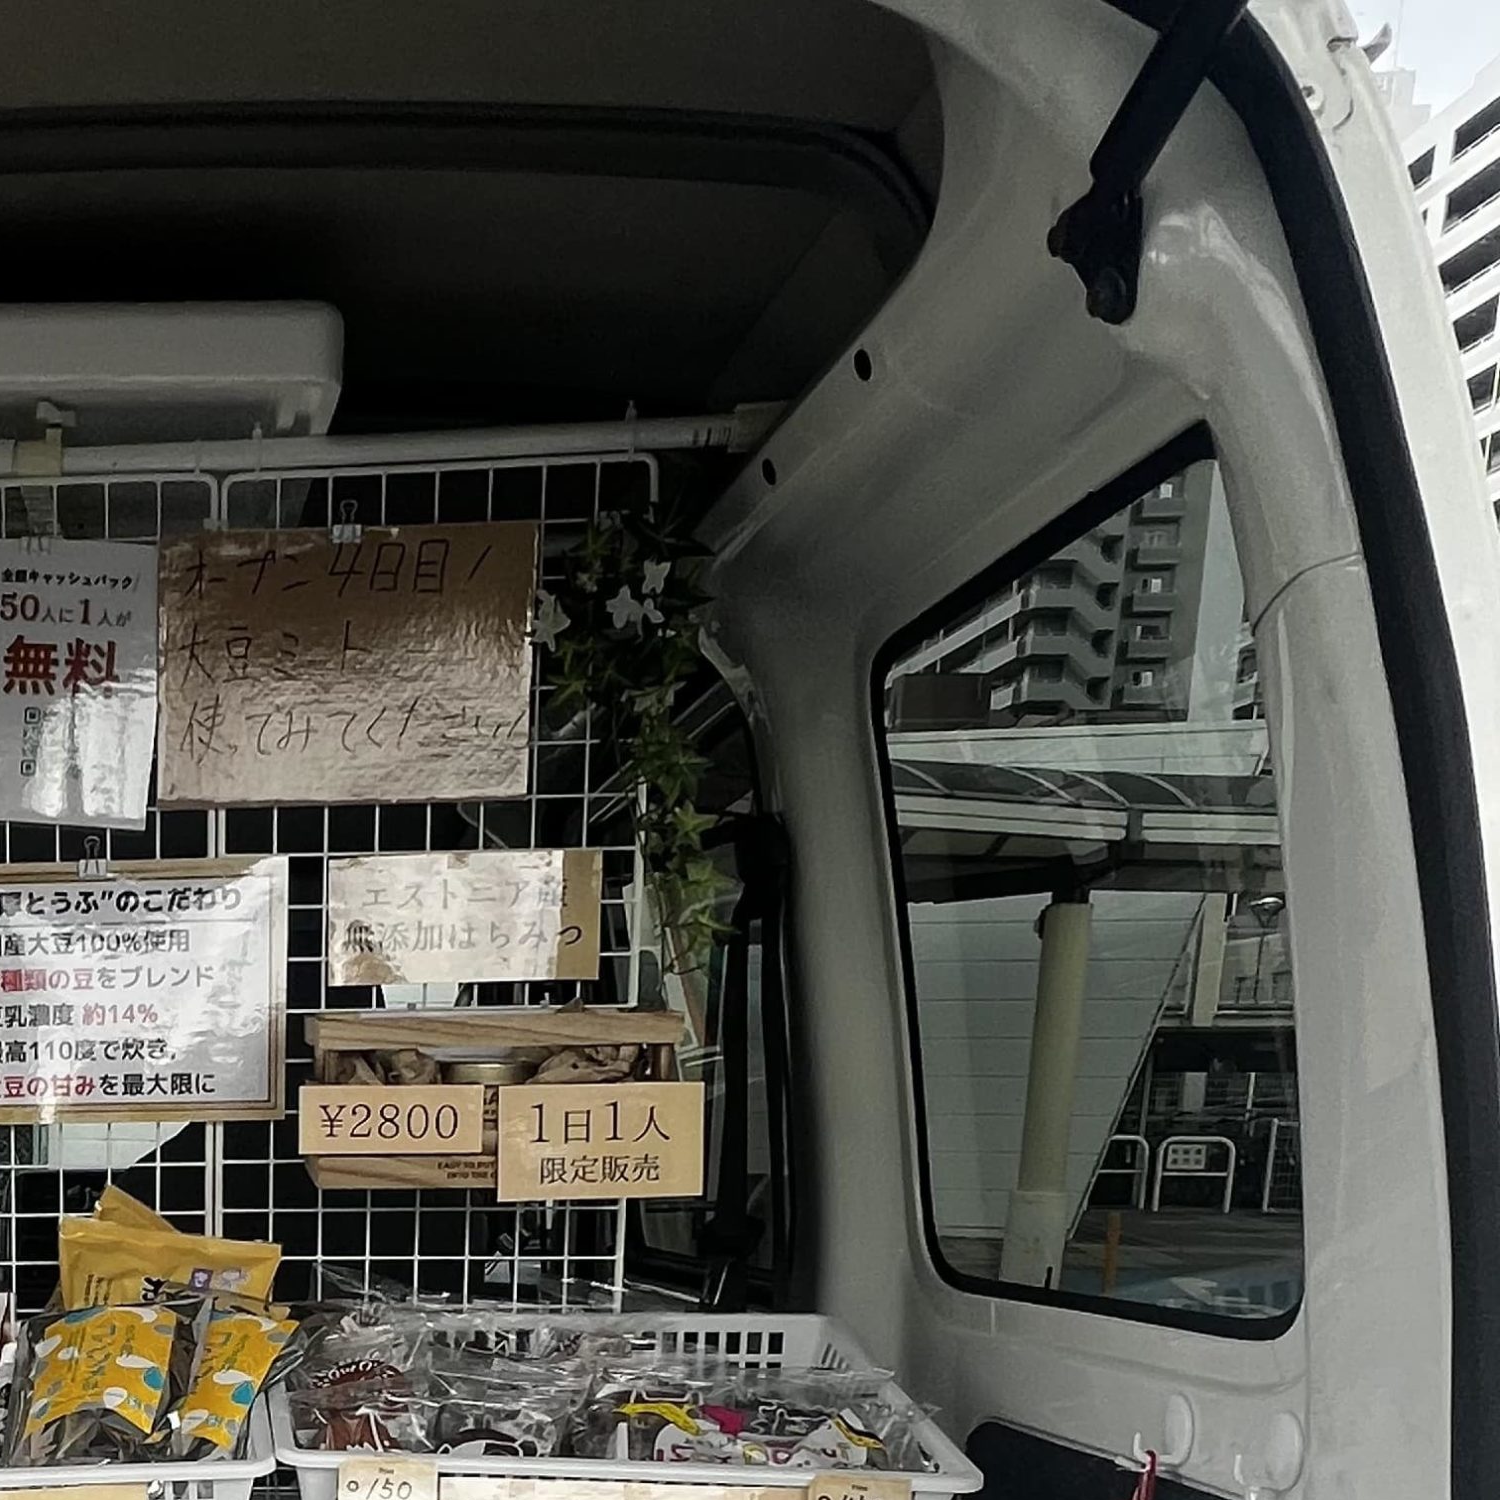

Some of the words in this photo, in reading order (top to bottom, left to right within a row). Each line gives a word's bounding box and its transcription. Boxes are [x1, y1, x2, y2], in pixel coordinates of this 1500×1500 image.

[0, 592, 131, 627] 50人に1人が
[3, 635, 120, 698] 無料
[178, 619, 372, 687] 大豆ミト
[319, 1104, 458, 1139] ¥2800
[531, 1101, 671, 1144] 1日1人
[540, 1154, 661, 1185] 限定販売
[366, 1478, 412, 1500] 150
